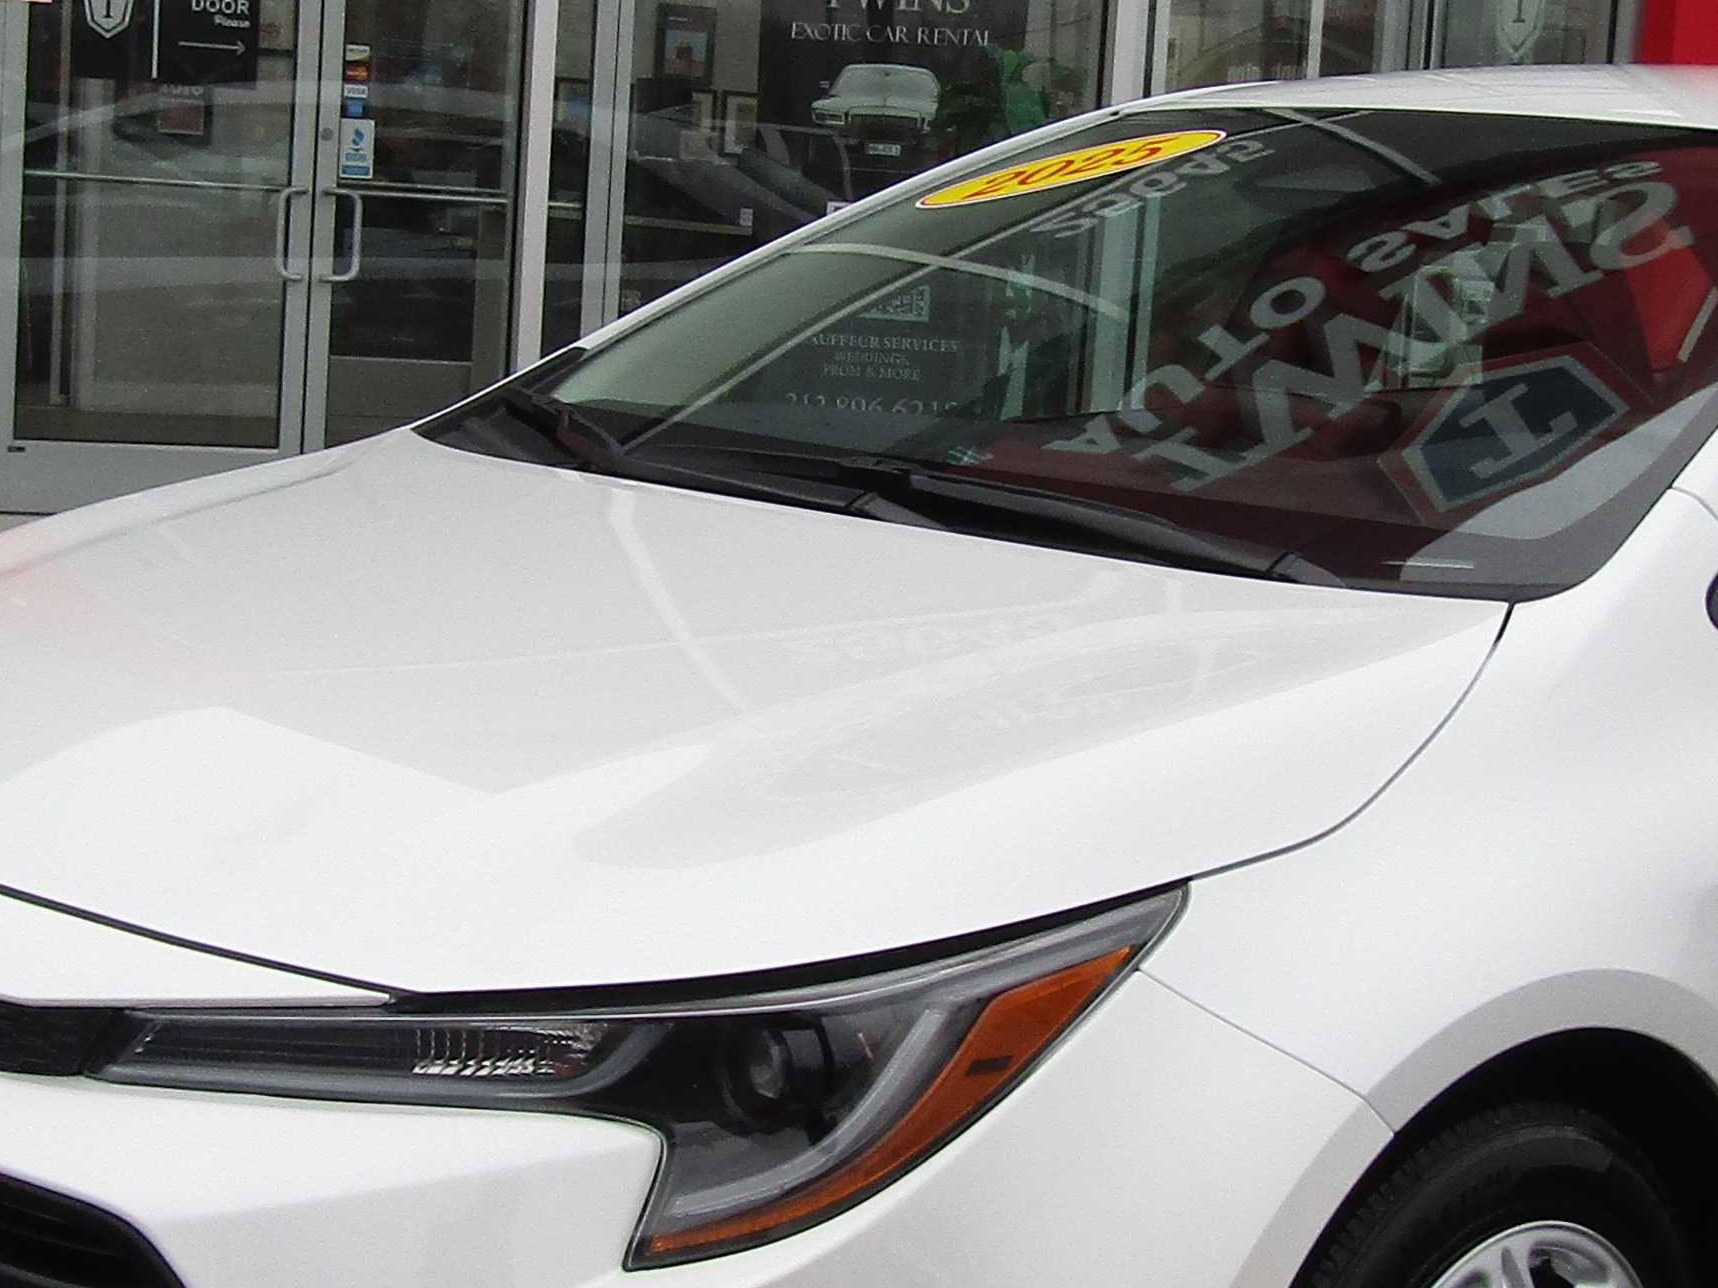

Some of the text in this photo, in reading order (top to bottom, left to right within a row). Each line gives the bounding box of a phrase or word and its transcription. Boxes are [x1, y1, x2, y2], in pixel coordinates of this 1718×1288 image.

[791, 21, 990, 47] EXOTIC CAR RENTAL
[960, 136, 1180, 200] 2025
[883, 337, 959, 353] SERVICES
[879, 366, 923, 380] MORE
